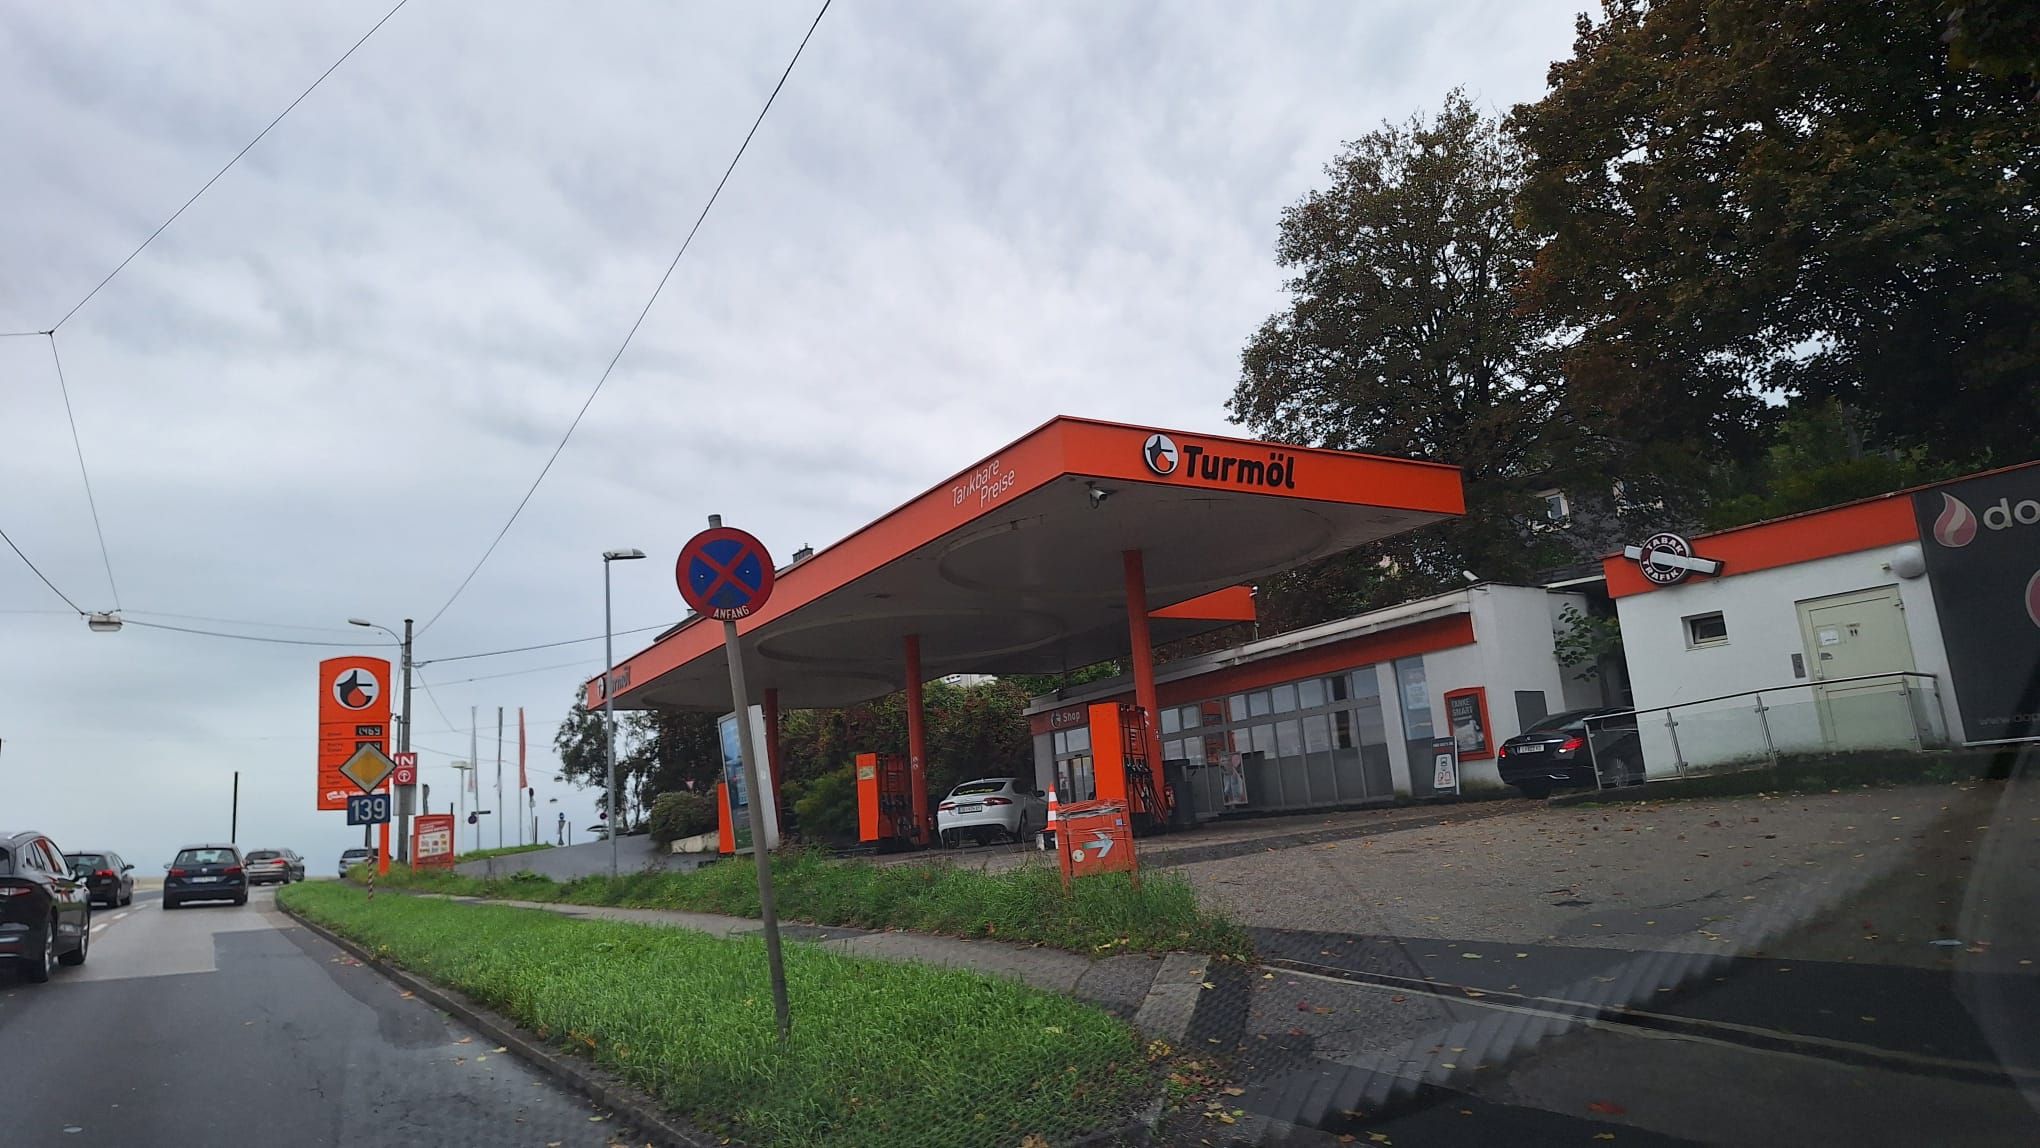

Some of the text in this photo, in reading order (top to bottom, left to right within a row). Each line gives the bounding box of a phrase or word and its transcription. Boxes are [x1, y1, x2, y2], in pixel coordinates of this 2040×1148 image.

[1183, 445, 1296, 489] Turmöl
[952, 460, 1000, 508] Tankbare
[980, 470, 1015, 508] Preise
[1983, 497, 2040, 531] do
[1645, 537, 1684, 554] TABAK
[1643, 559, 1680, 581] TRAFIK
[713, 605, 750, 619] ANFANG
[1062, 711, 1080, 722] Shop
[395, 755, 414, 766] IN
[351, 798, 386, 822] 139
